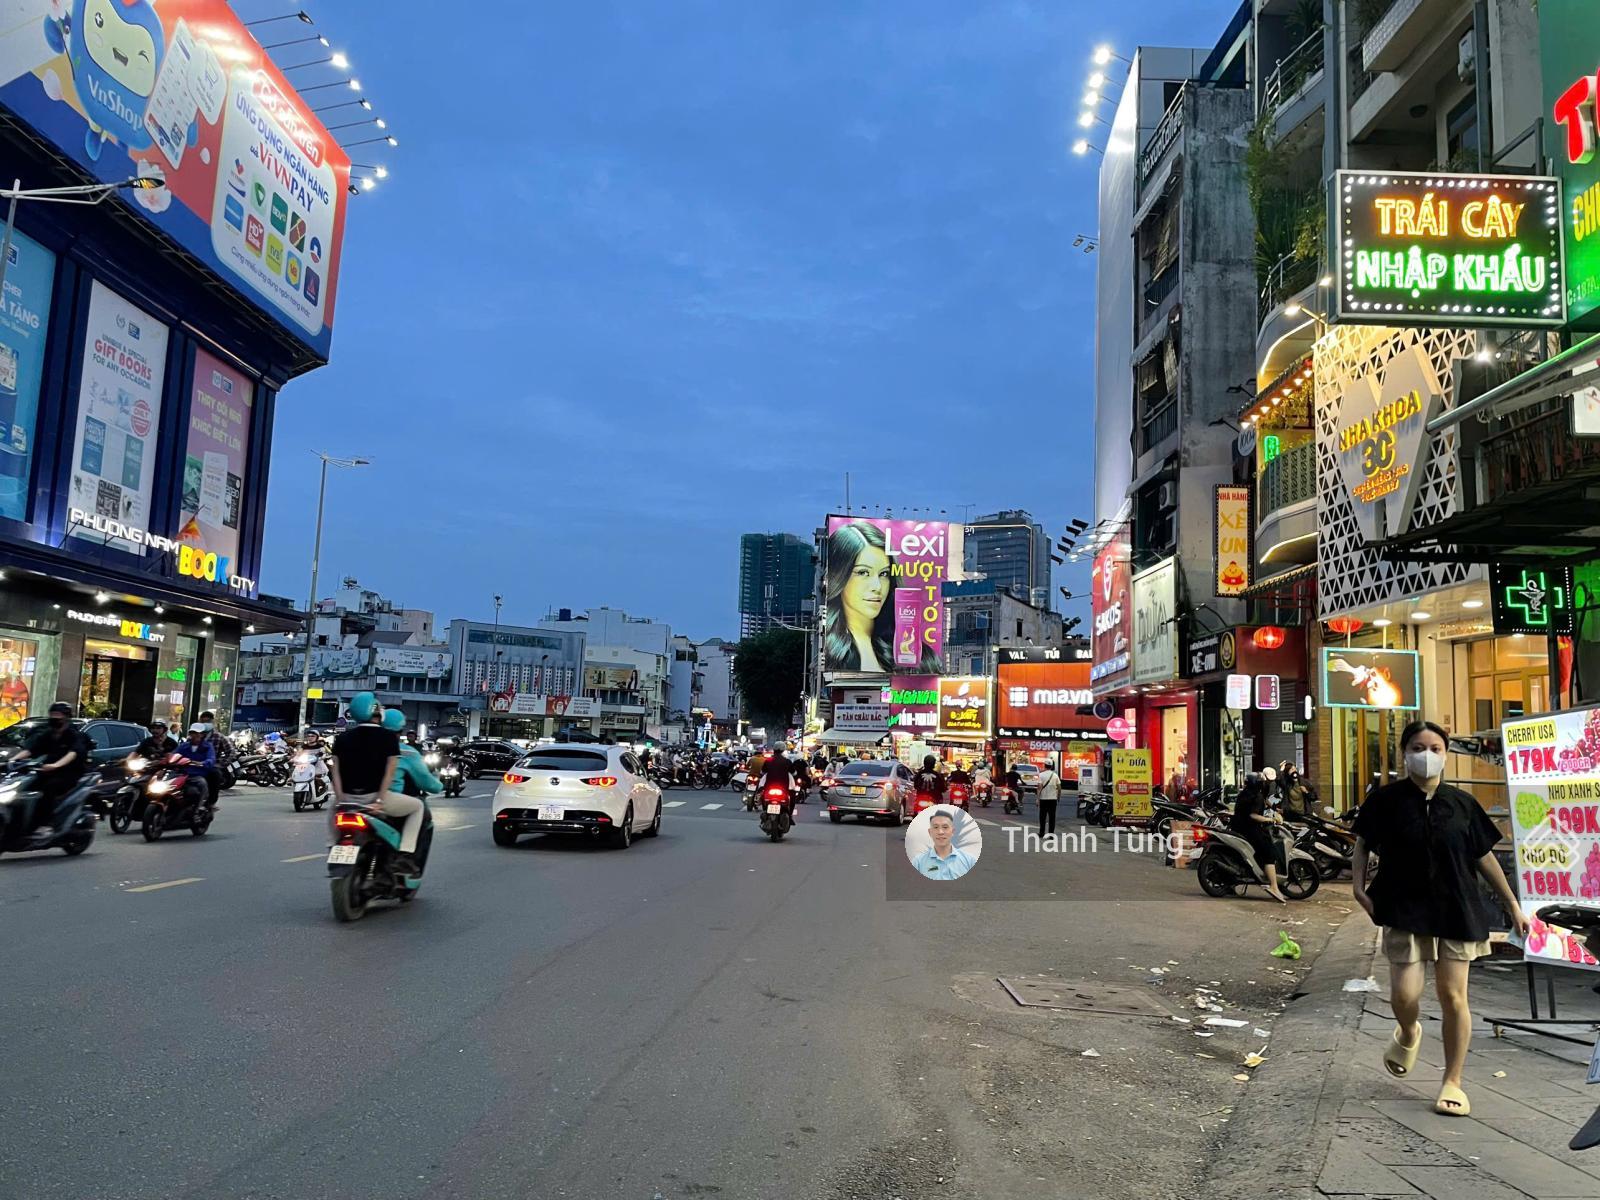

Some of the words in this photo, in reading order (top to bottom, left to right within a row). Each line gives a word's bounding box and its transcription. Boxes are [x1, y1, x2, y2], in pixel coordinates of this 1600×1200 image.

[88, 74, 142, 131] VnShop
[257, 119, 283, 154] DỤNG
[283, 149, 307, 181] NGÂN
[307, 173, 329, 205] HÀNG
[274, 157, 314, 213] VNPAY
[1374, 192, 1448, 237] TRÁI
[1461, 194, 1525, 238] CÂY
[1356, 245, 1447, 299] NHẬP
[10, 302, 40, 329] TẶNG
[92, 353, 106, 366] FOR
[106, 361, 119, 373] ANY
[95, 339, 117, 361] GIFT
[119, 352, 152, 380] BOOKS
[1371, 389, 1422, 433] KHOA
[884, 523, 945, 557] Léxi
[144, 531, 179, 555] NAM
[178, 544, 230, 585] BOOK
[230, 575, 256, 592] CITY
[891, 558, 944, 583] MƯỢT
[121, 619, 151, 640] BOOK
[149, 633, 165, 642] CITY
[1044, 647, 1060, 659] TÚI
[1033, 689, 1094, 705] mia.vn
[1029, 740, 1056, 751] 599K
[1507, 725, 1536, 744] CHERRY
[1537, 723, 1554, 740] USA
[1508, 746, 1558, 775] 179K
[1548, 784, 1566, 801] NHO
[1568, 782, 1593, 799] XANH
[1522, 848, 1546, 864] NHO
[1522, 870, 1574, 897] 169K
